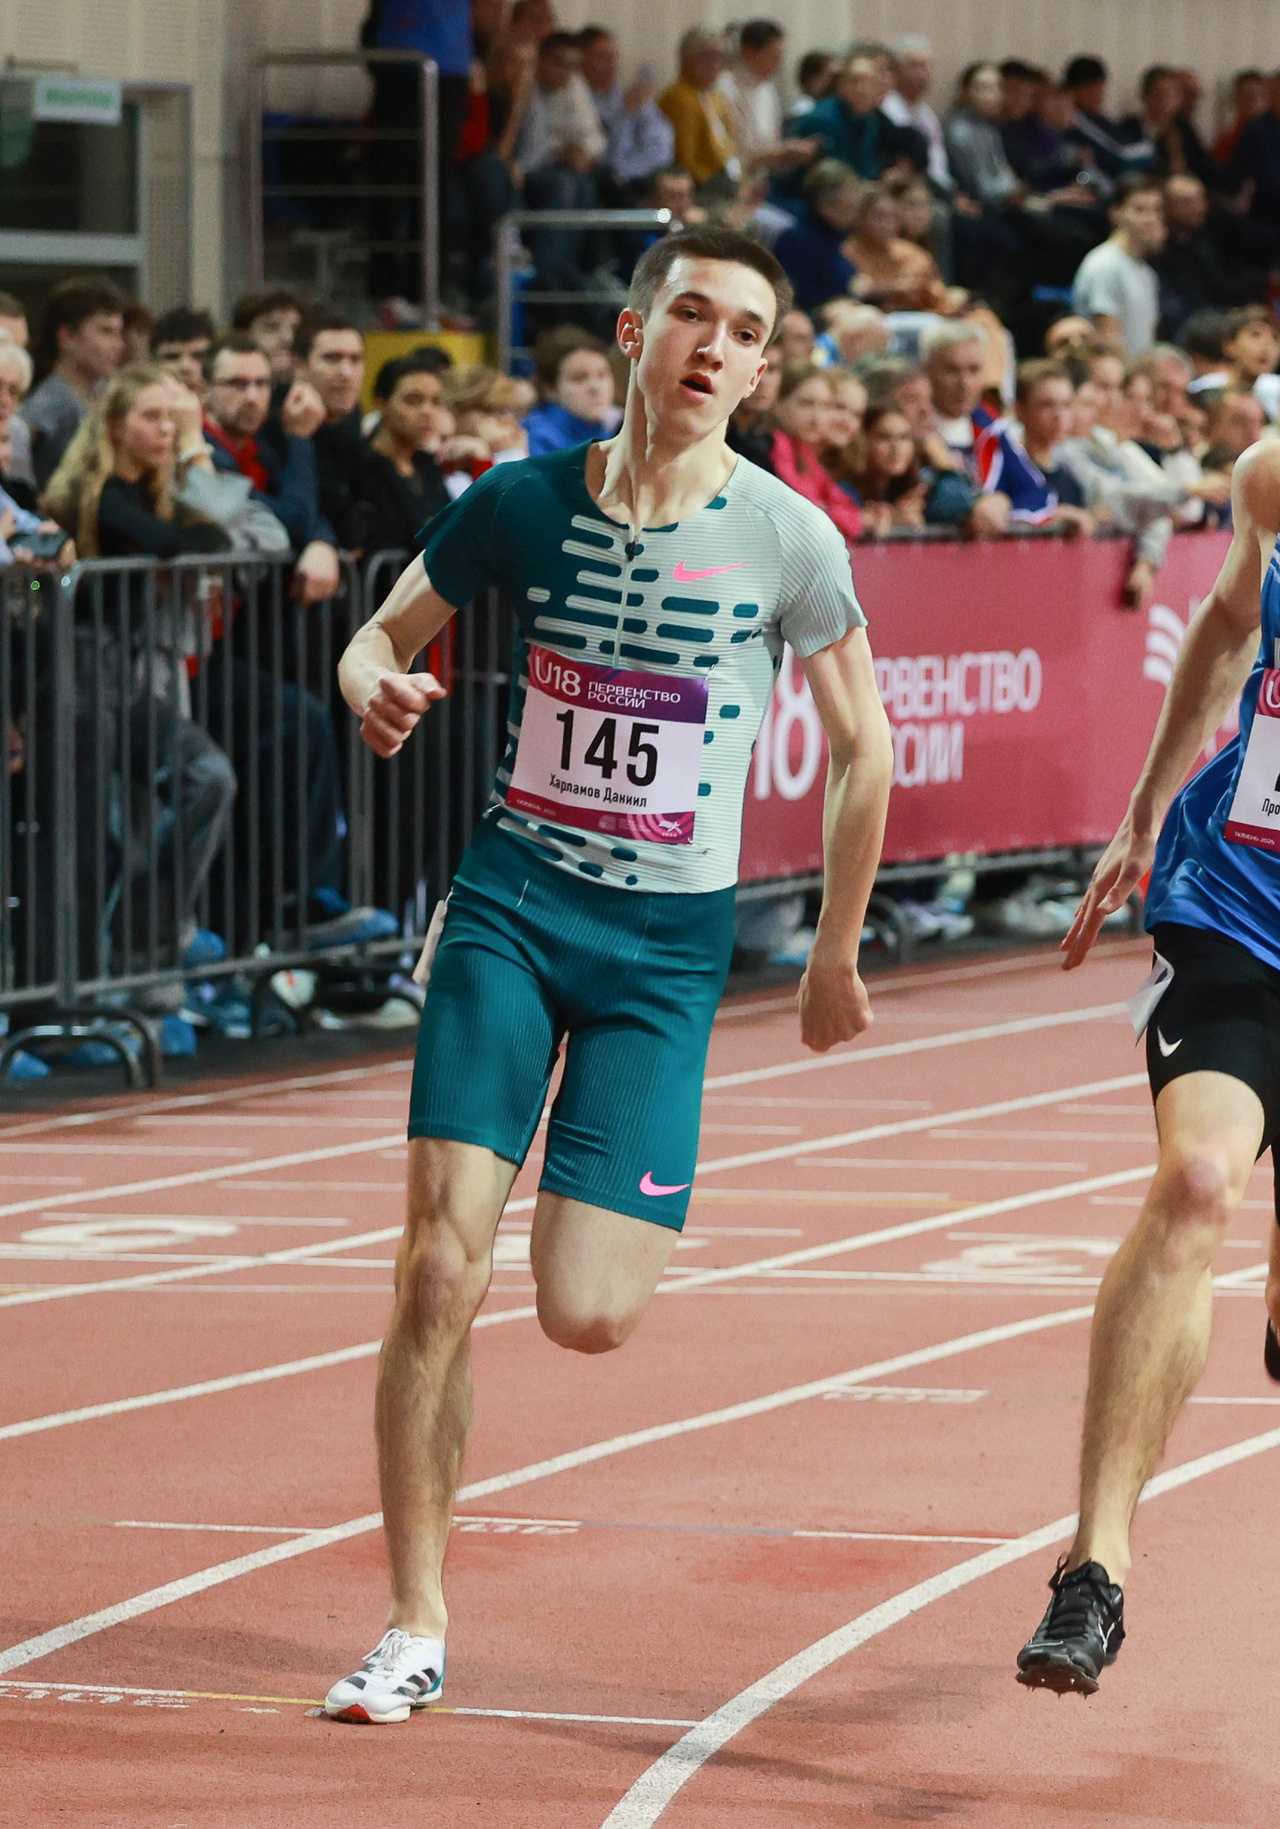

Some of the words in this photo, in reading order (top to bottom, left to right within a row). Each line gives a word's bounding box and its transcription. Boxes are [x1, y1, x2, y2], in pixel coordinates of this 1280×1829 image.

[535, 655, 581, 697] U18
[588, 681, 681, 703] ПЕРВЕНСТВО
[588, 691, 646, 709] РОССИИ
[873, 647, 1042, 720] РВЕНСТВО
[752, 640, 823, 800] 18
[556, 709, 660, 787] 145
[891, 720, 964, 787] СИИ
[549, 773, 600, 798] Харламов
[602, 787, 647, 807] Даниил
